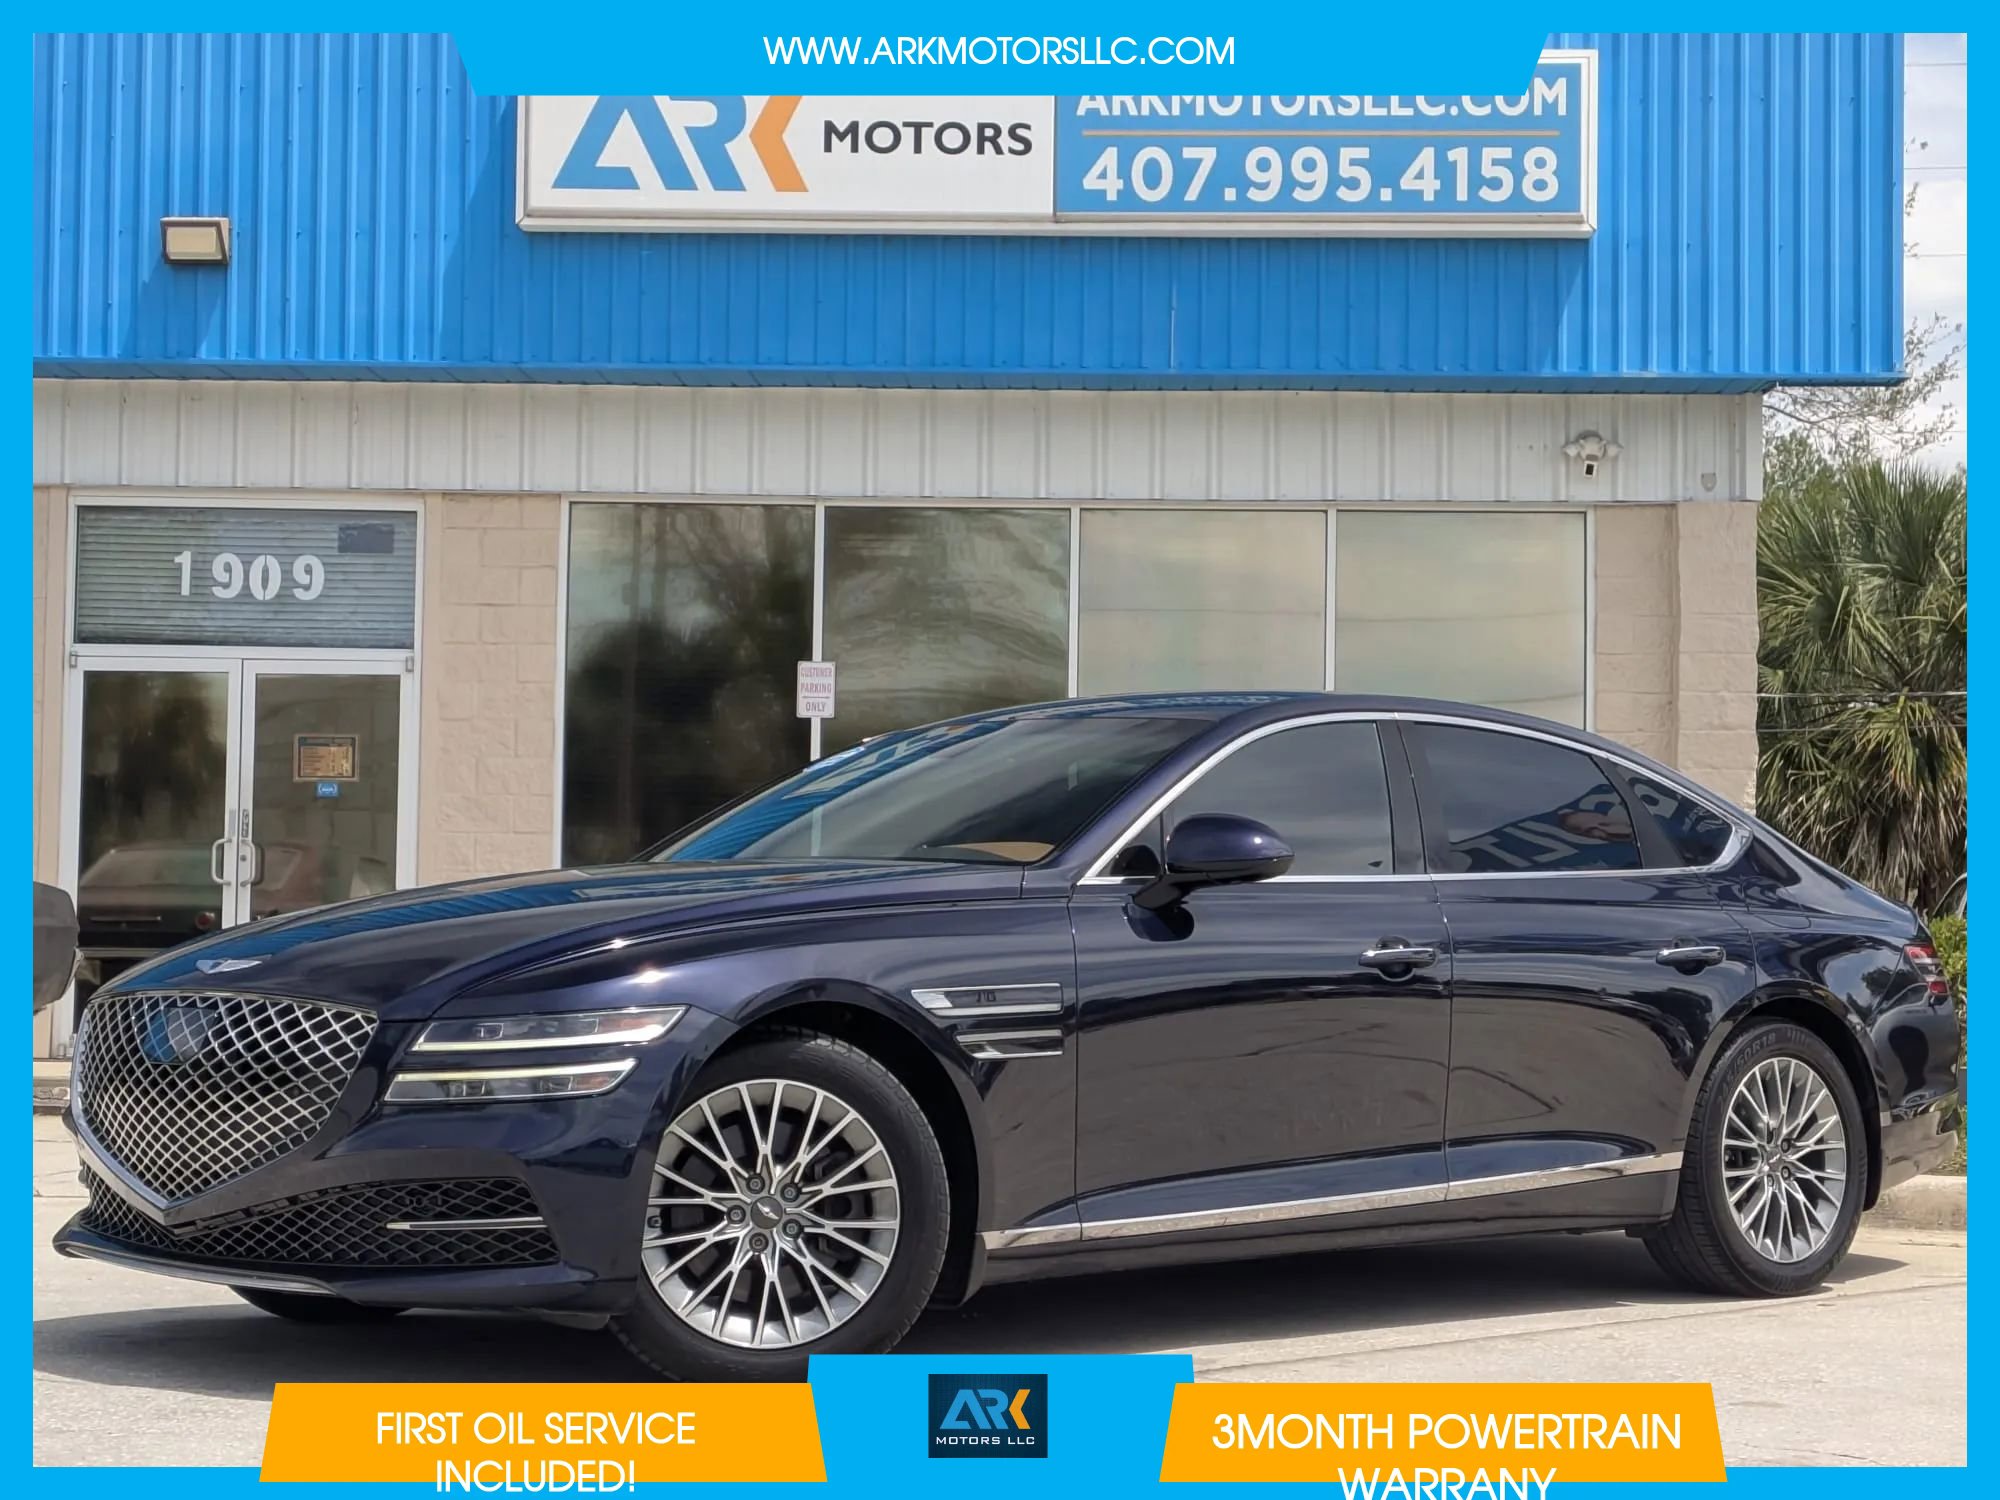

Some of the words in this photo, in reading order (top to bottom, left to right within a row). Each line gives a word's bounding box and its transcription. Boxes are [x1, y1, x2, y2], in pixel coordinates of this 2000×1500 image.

[551, 95, 810, 193] ARK
[823, 119, 1033, 157] MOTORS
[1082, 145, 1560, 203] 407.995.4158
[174, 551, 325, 600] 1909
[800, 682, 832, 693] PARKING
[805, 702, 826, 712] ONLY
